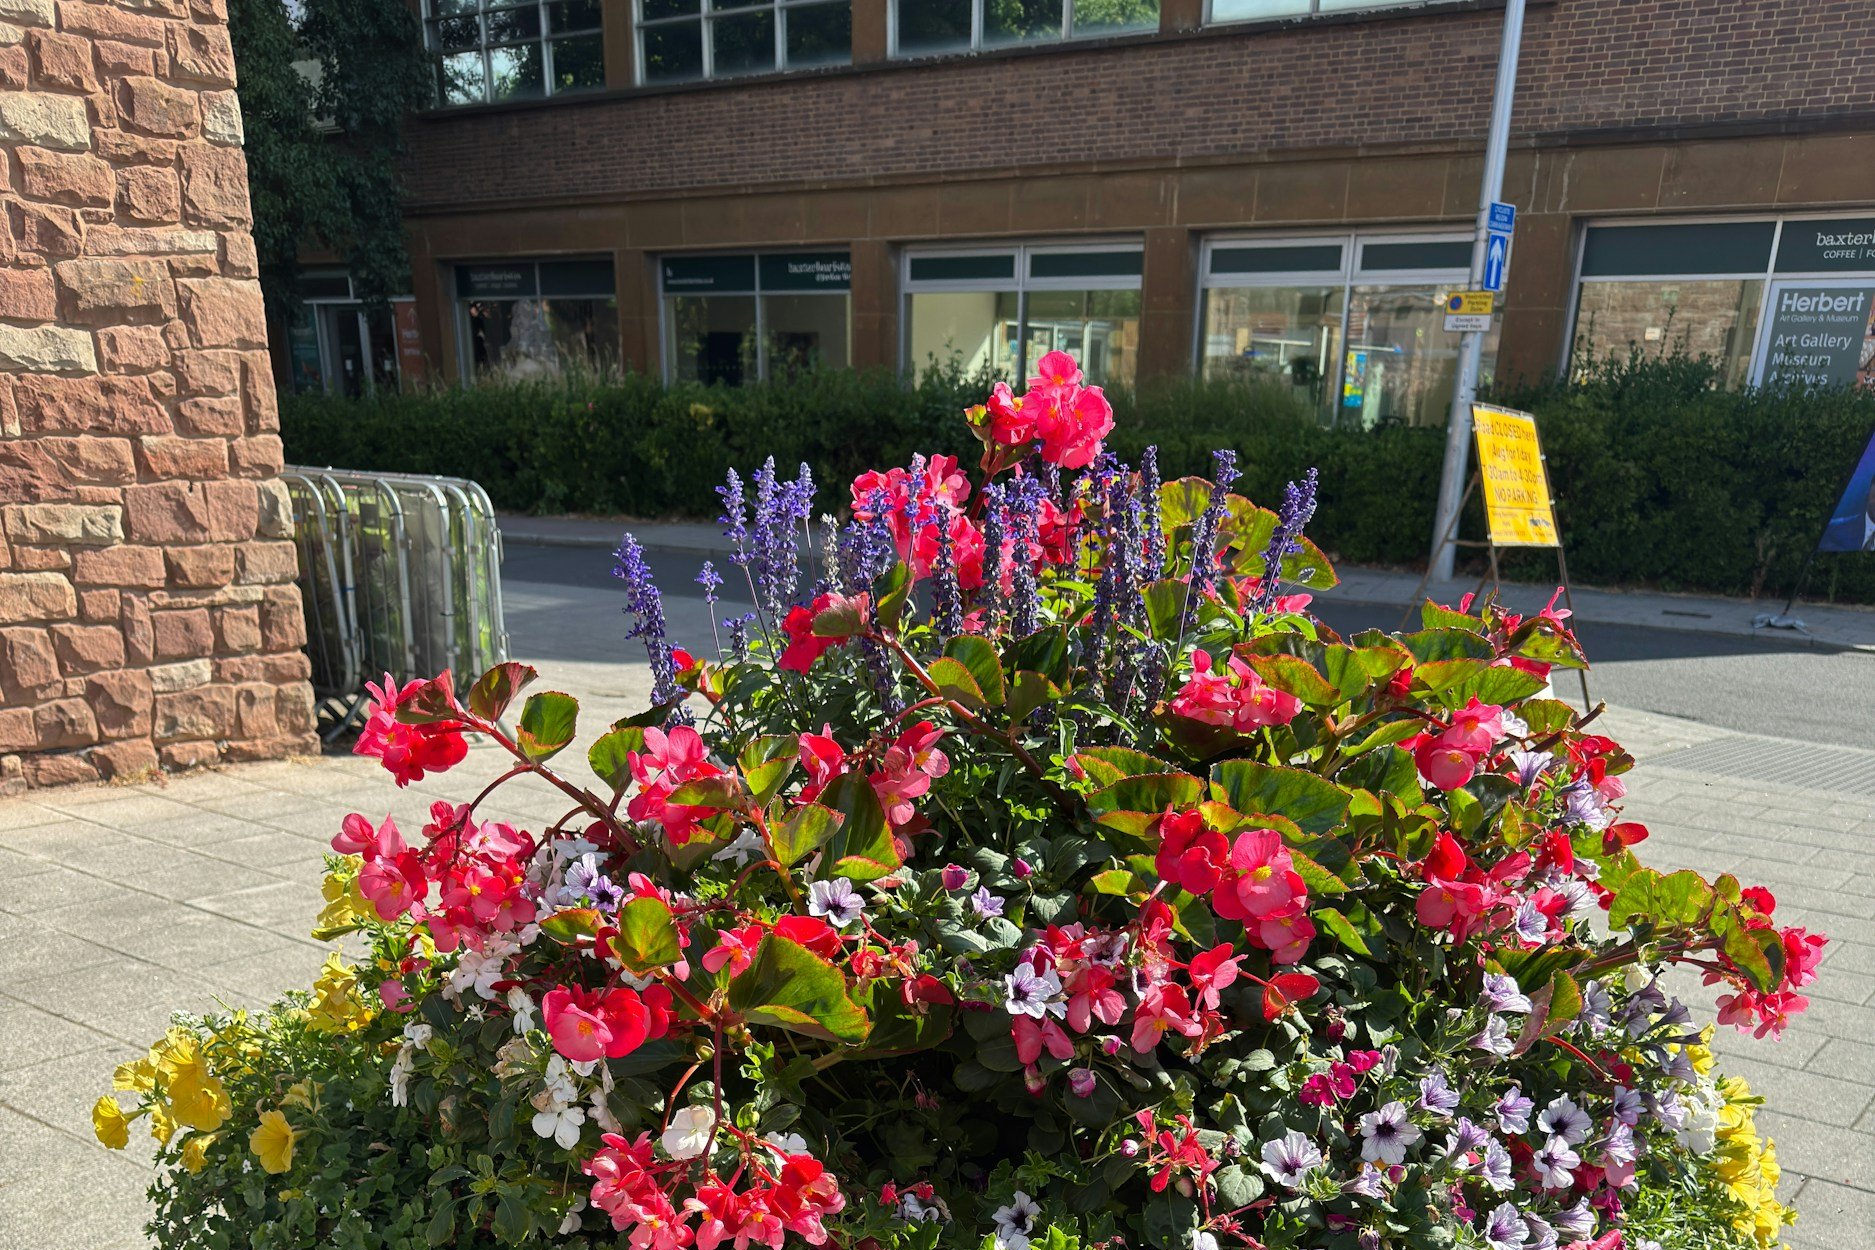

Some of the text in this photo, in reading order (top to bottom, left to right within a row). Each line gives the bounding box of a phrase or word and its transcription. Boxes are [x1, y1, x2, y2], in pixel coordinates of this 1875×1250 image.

[1823, 250, 1856, 259] COFFEE
[1781, 292, 1865, 312] Herbert
[1780, 314, 1790, 322] Art
[1791, 314, 1817, 323] Gallery
[1826, 314, 1859, 322] Museum
[1775, 333, 1852, 350] Art Gallery
[1495, 421, 1522, 439] CLOSED
[1494, 487, 1538, 505] NO PARKING
